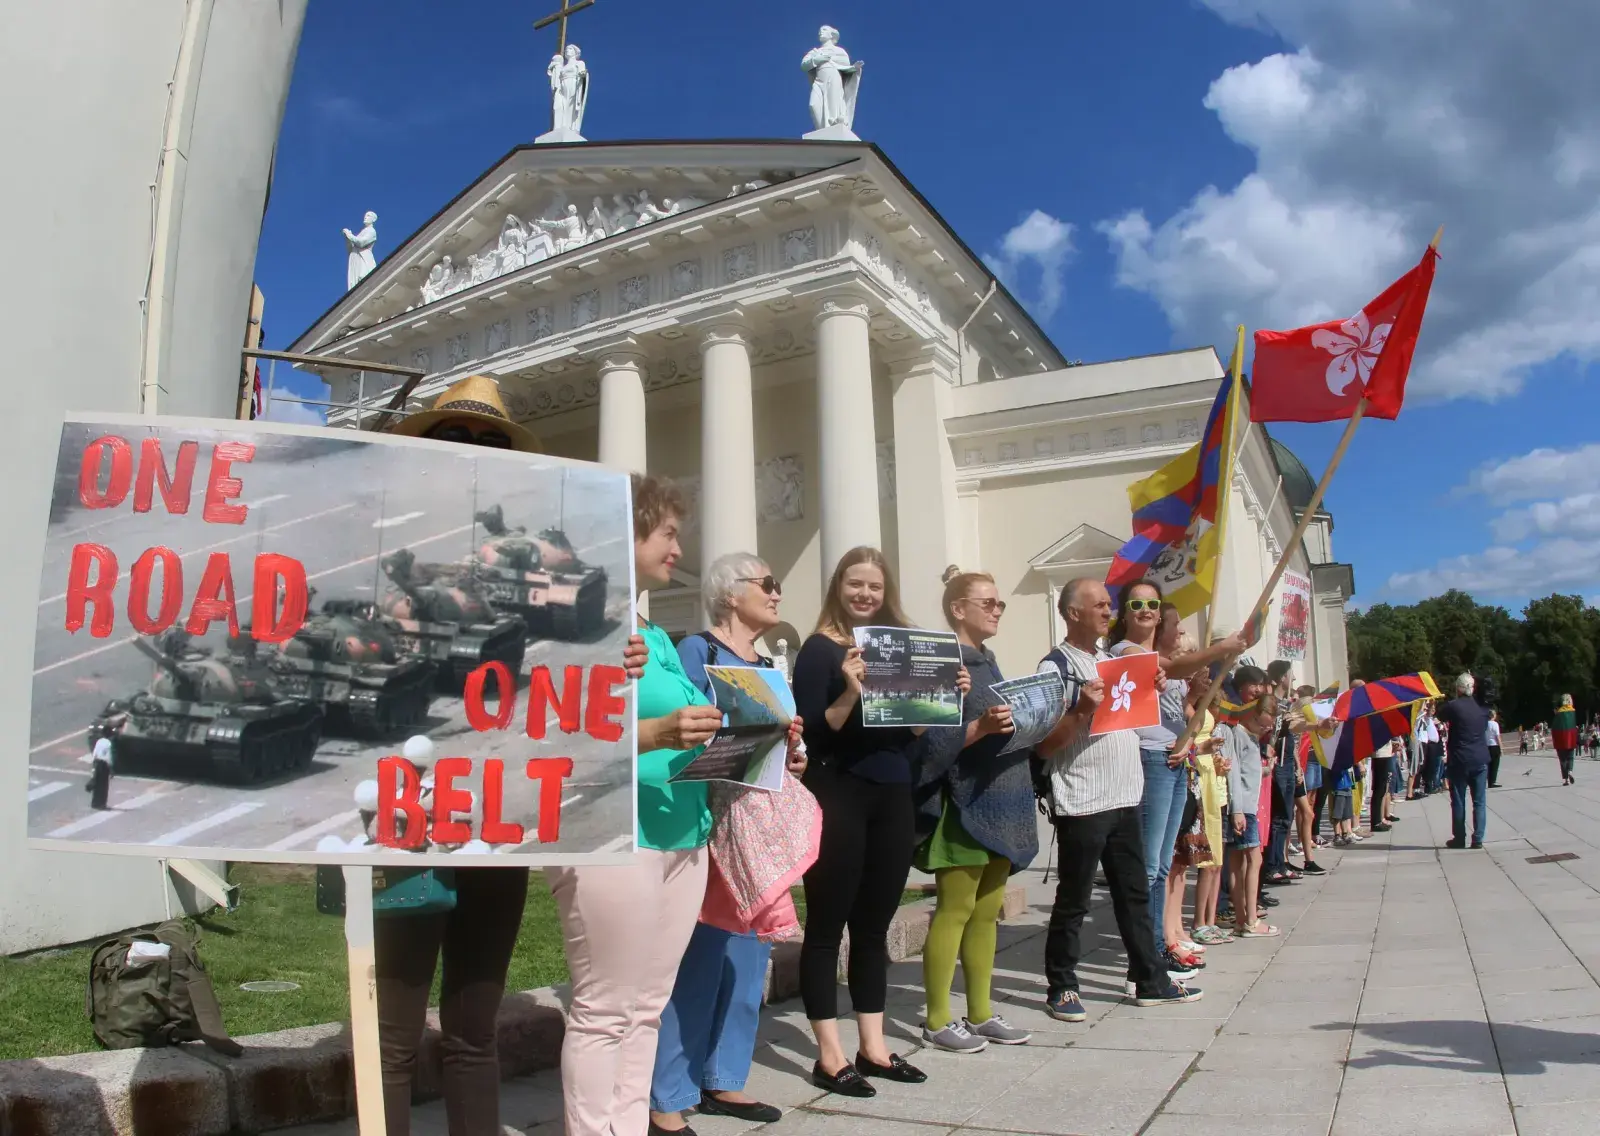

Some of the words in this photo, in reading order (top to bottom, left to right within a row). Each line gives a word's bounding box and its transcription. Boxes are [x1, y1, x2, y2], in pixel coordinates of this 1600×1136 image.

[80, 436, 254, 523] ONE
[66, 543, 307, 644] ROAD
[464, 661, 627, 742] ONE
[376, 756, 574, 848] BELT
